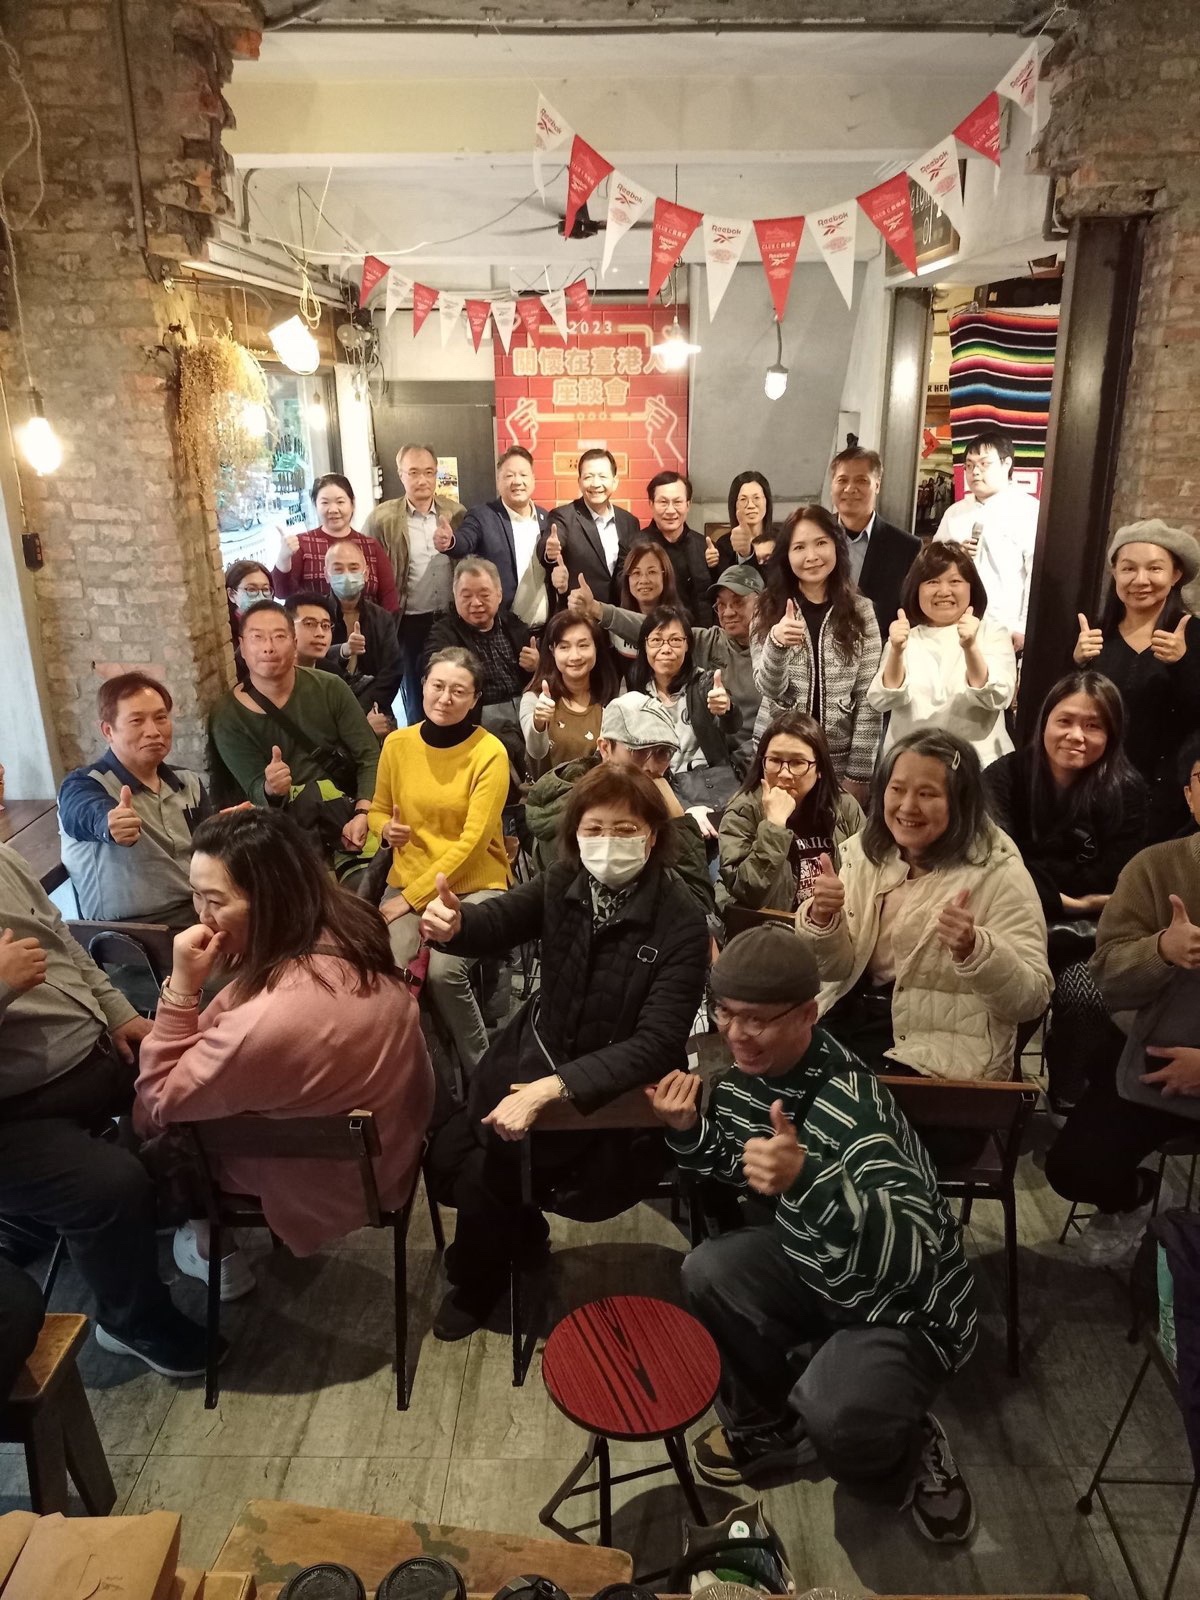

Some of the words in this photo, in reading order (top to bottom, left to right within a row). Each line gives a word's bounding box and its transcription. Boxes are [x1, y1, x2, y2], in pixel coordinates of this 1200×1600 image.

[540, 108, 561, 134] Reebok
[920, 151, 948, 173] Reebok
[617, 183, 643, 203] Reebok
[817, 212, 848, 226] Reebok
[711, 225, 741, 235] Reebok
[568, 320, 612, 335] 2023
[552, 377, 630, 406] 座談會
